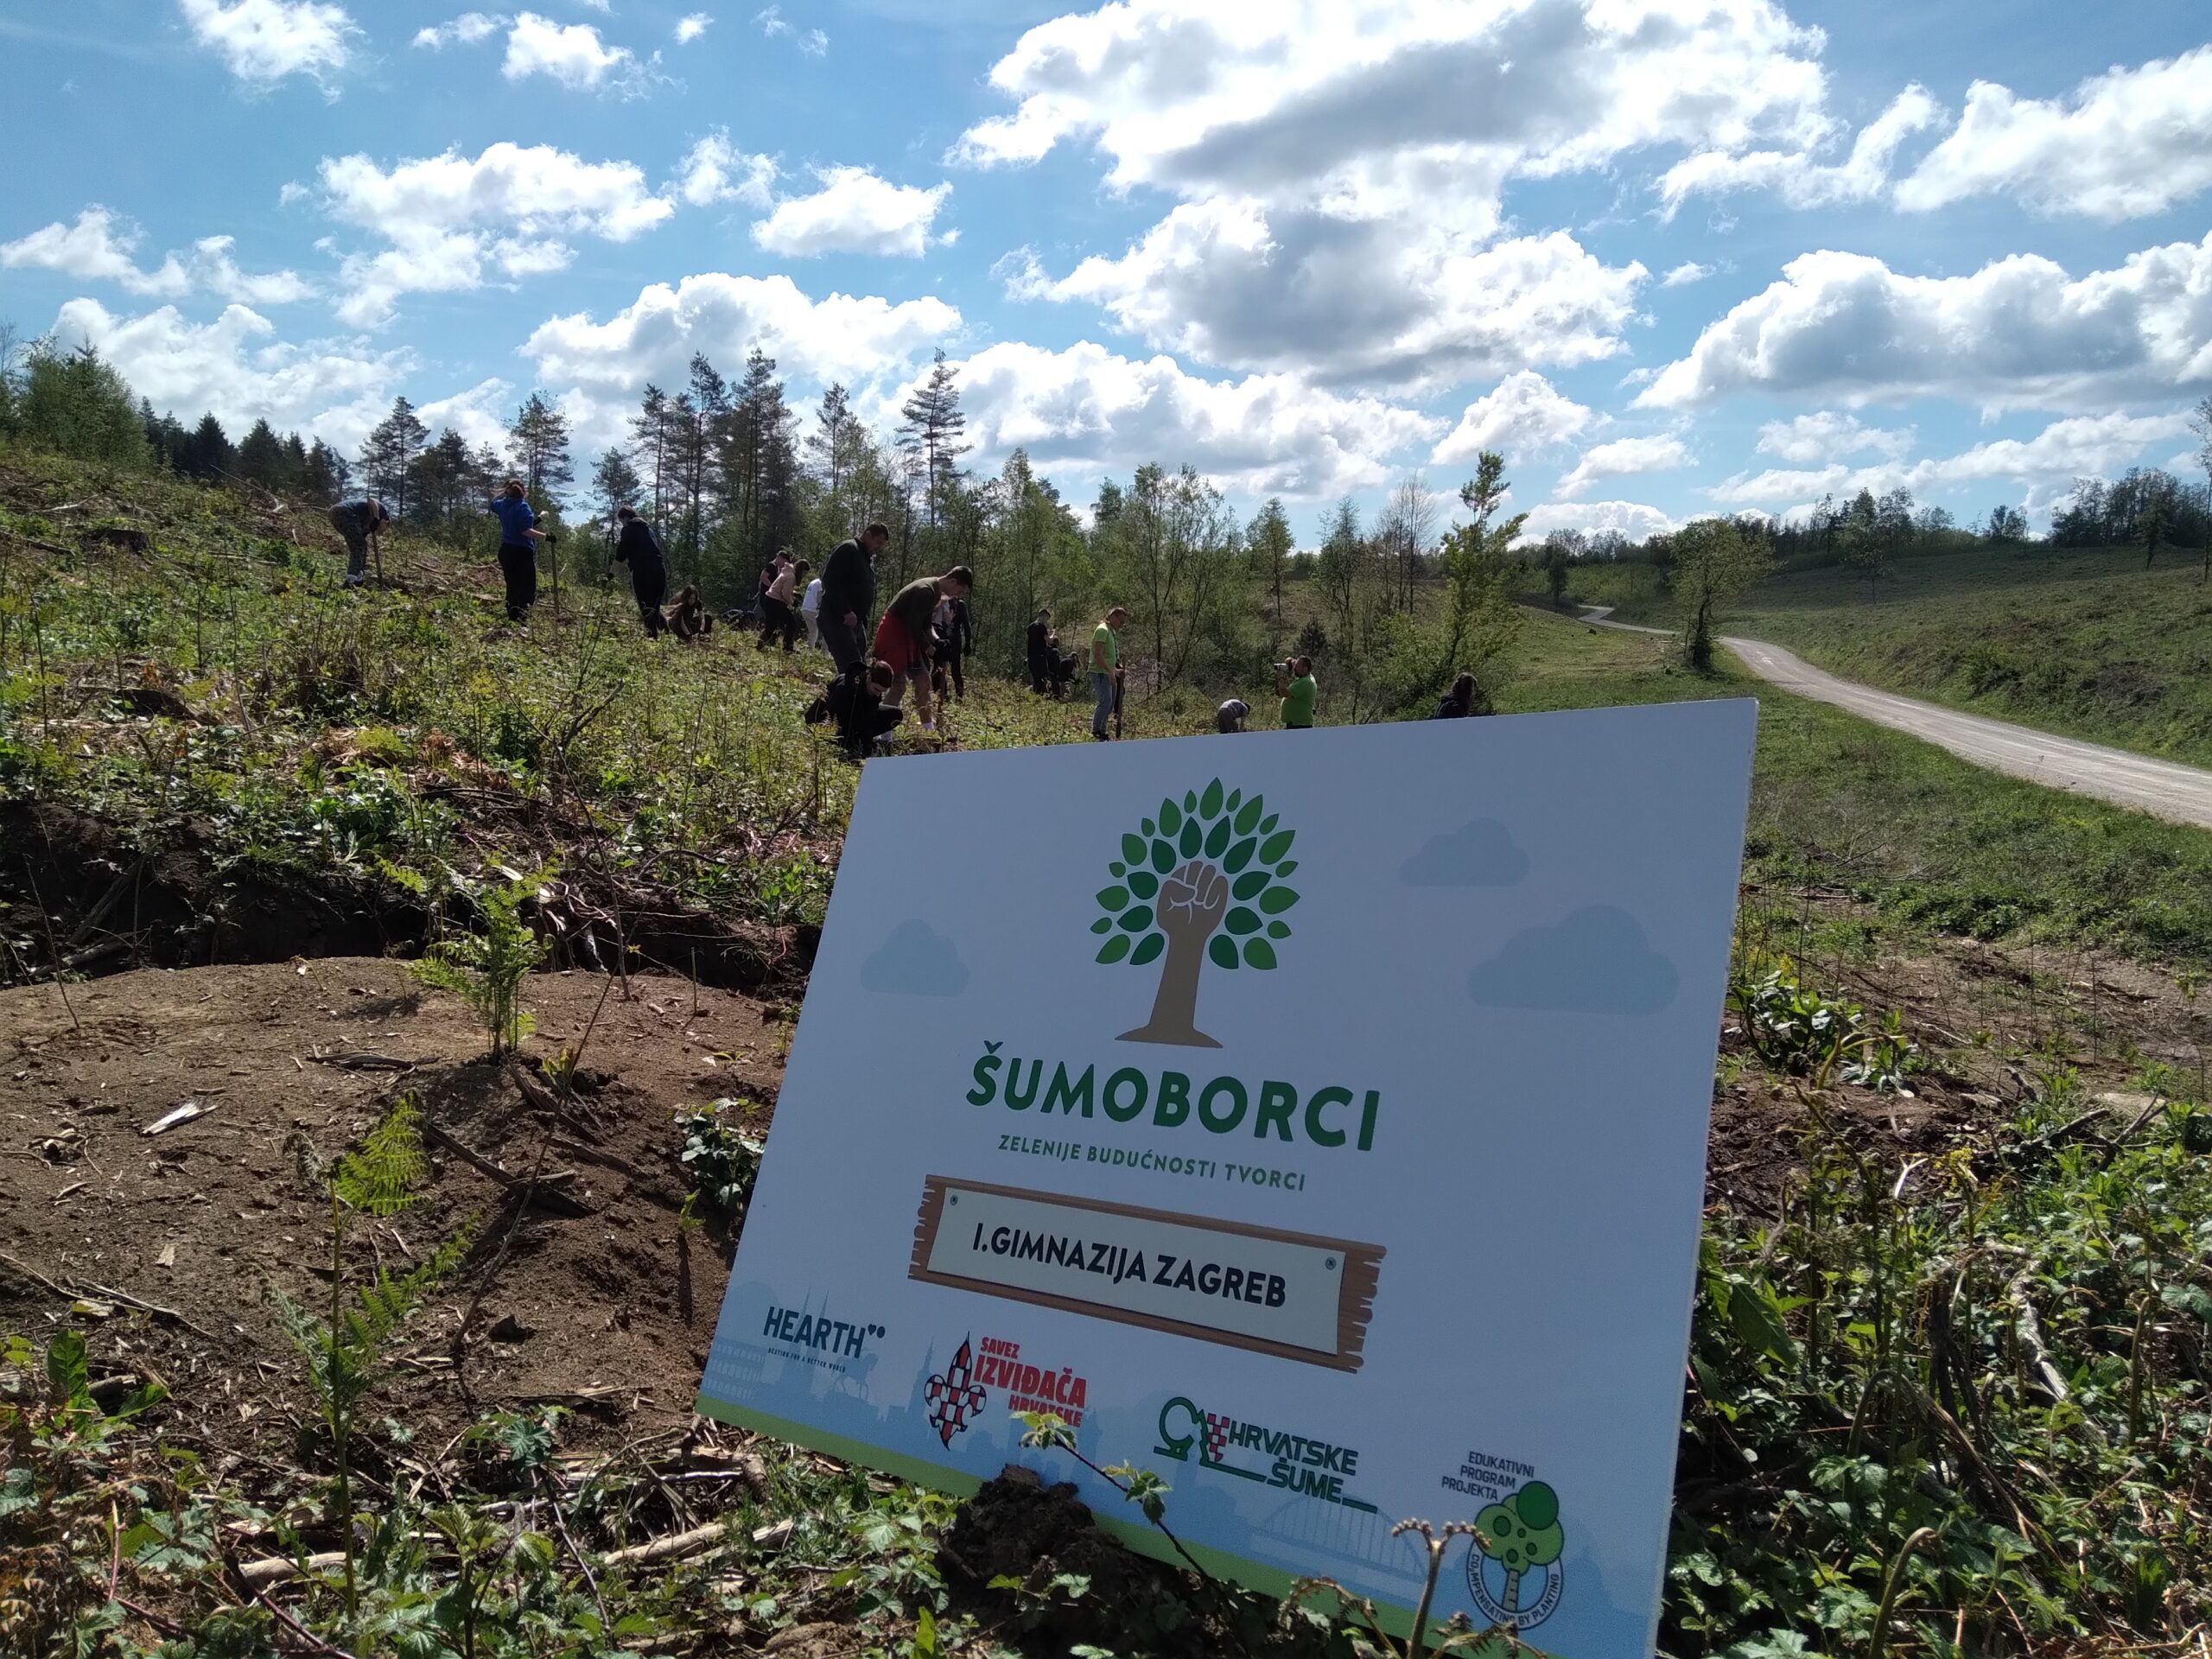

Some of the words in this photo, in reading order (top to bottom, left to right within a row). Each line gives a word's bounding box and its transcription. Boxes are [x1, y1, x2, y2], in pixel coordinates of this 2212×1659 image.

[965, 1039, 1381, 1152] ŠUMOBORCI
[998, 1135, 1082, 1162] ZELENIJE
[1086, 1146, 1217, 1179] BUDUĆNOSTI
[1224, 1163, 1306, 1192] TVORCI
[1153, 1255, 1287, 1309] ZAGREB
[763, 1306, 867, 1359] HEARTH
[980, 1336, 1020, 1360] SAVEZ
[973, 1354, 1087, 1409] IZVIĐAČA
[1228, 1420, 1359, 1477] HRVATSKE
[1468, 1451, 1535, 1478] EDUKATIVNI
[1267, 1457, 1344, 1503] ŠUME
[1441, 1476, 1498, 1502] PROJEKTA
[1459, 1465, 1516, 1490] PROGRAM
[1518, 1615, 1531, 1625] BY
